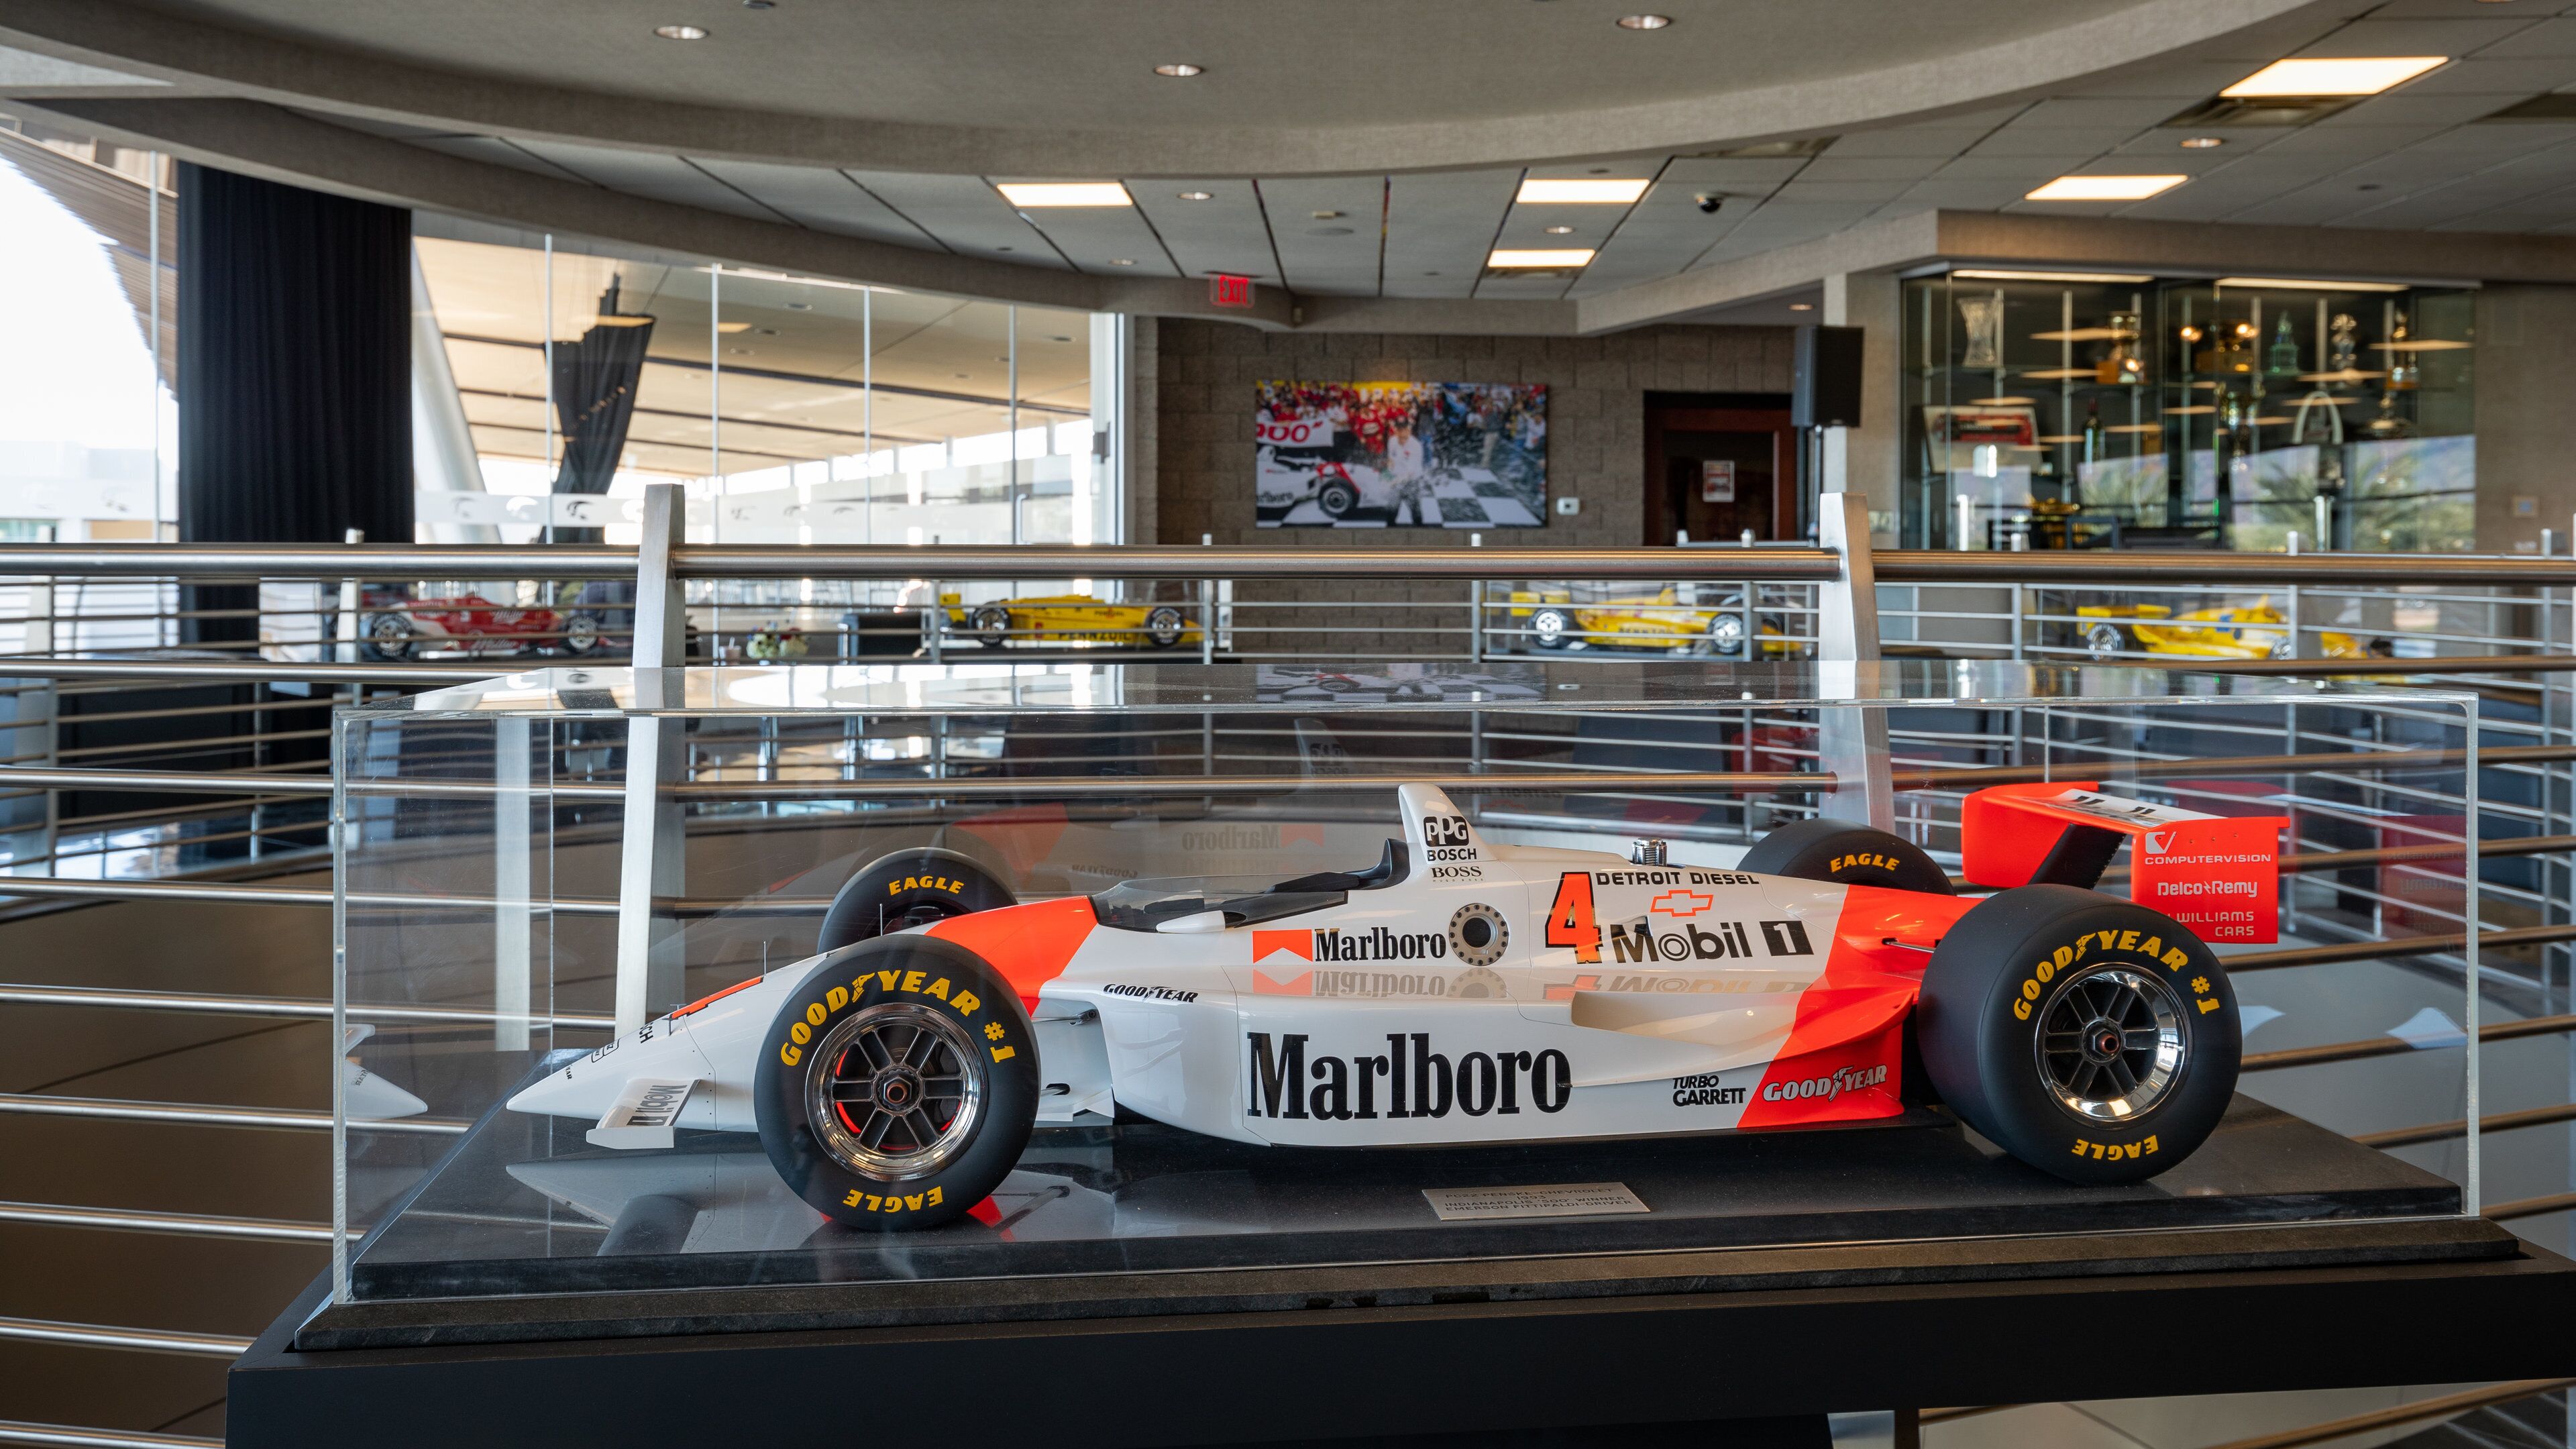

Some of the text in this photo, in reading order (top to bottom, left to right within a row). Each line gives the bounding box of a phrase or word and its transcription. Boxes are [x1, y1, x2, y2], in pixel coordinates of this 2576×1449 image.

[1219, 274, 1249, 304] EXIT
[1426, 815, 1468, 845] PPG
[1426, 848, 1477, 862] BOSCH
[1830, 853, 1900, 873] EAGLE
[2145, 854, 2271, 865] COMPUTERVISION
[888, 875, 965, 896] EAGLE
[1431, 866, 1483, 878] BOSS
[1595, 871, 1760, 885] DETROIT DIESEL
[1544, 871, 1604, 964] 4
[2176, 911, 2255, 923] WILLIAMS
[1315, 926, 1447, 963] Marlboro
[1610, 921, 1753, 964] Mobil
[2215, 925, 2255, 937] CARS
[1103, 983, 1199, 1004] GOODYEAR
[2191, 975, 2221, 1016] #1
[984, 1021, 1016, 1064] #1
[1246, 1032, 1572, 1121] Marlboro
[1672, 1075, 1719, 1090] TURBO
[1762, 1064, 1888, 1102] GOODYEAR
[635, 1085, 688, 1112] Mobil
[1672, 1087, 1746, 1108] GARRETT
[2071, 1134, 2160, 1161] EAGLE
[843, 1185, 944, 1214] EAGLE
